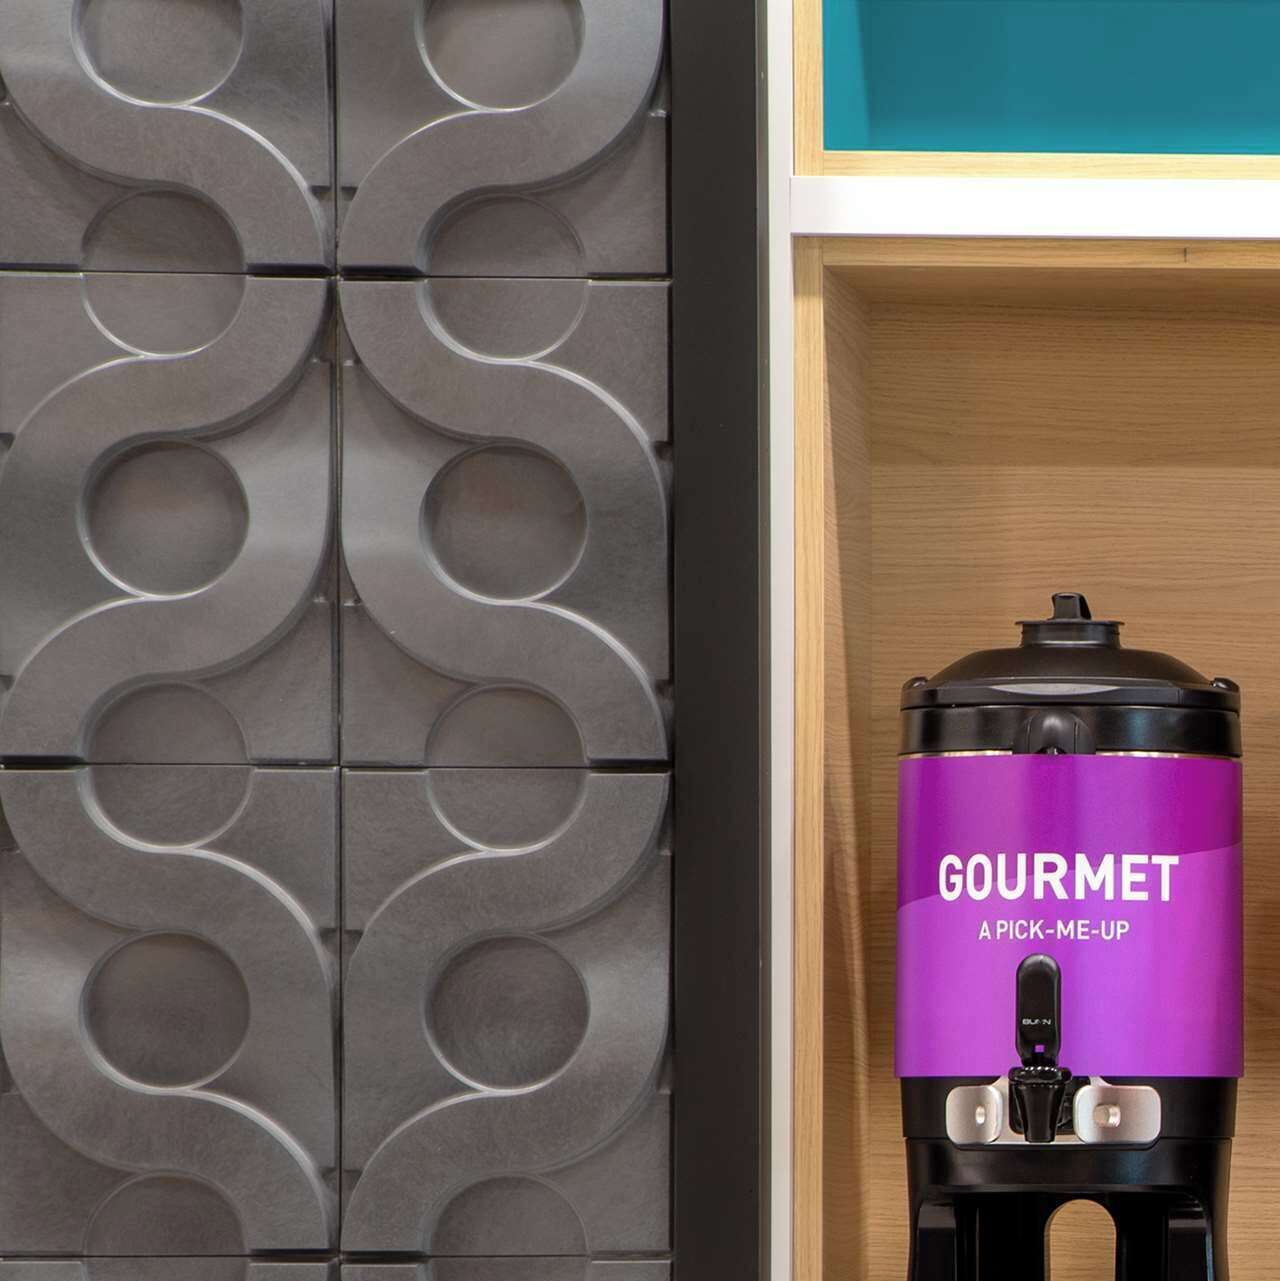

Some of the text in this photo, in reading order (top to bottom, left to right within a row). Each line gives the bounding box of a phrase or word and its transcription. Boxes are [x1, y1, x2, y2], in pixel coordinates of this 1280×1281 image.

[938, 852, 1180, 902] GOURMET
[978, 919, 1130, 941] A PICK-ME-UP
